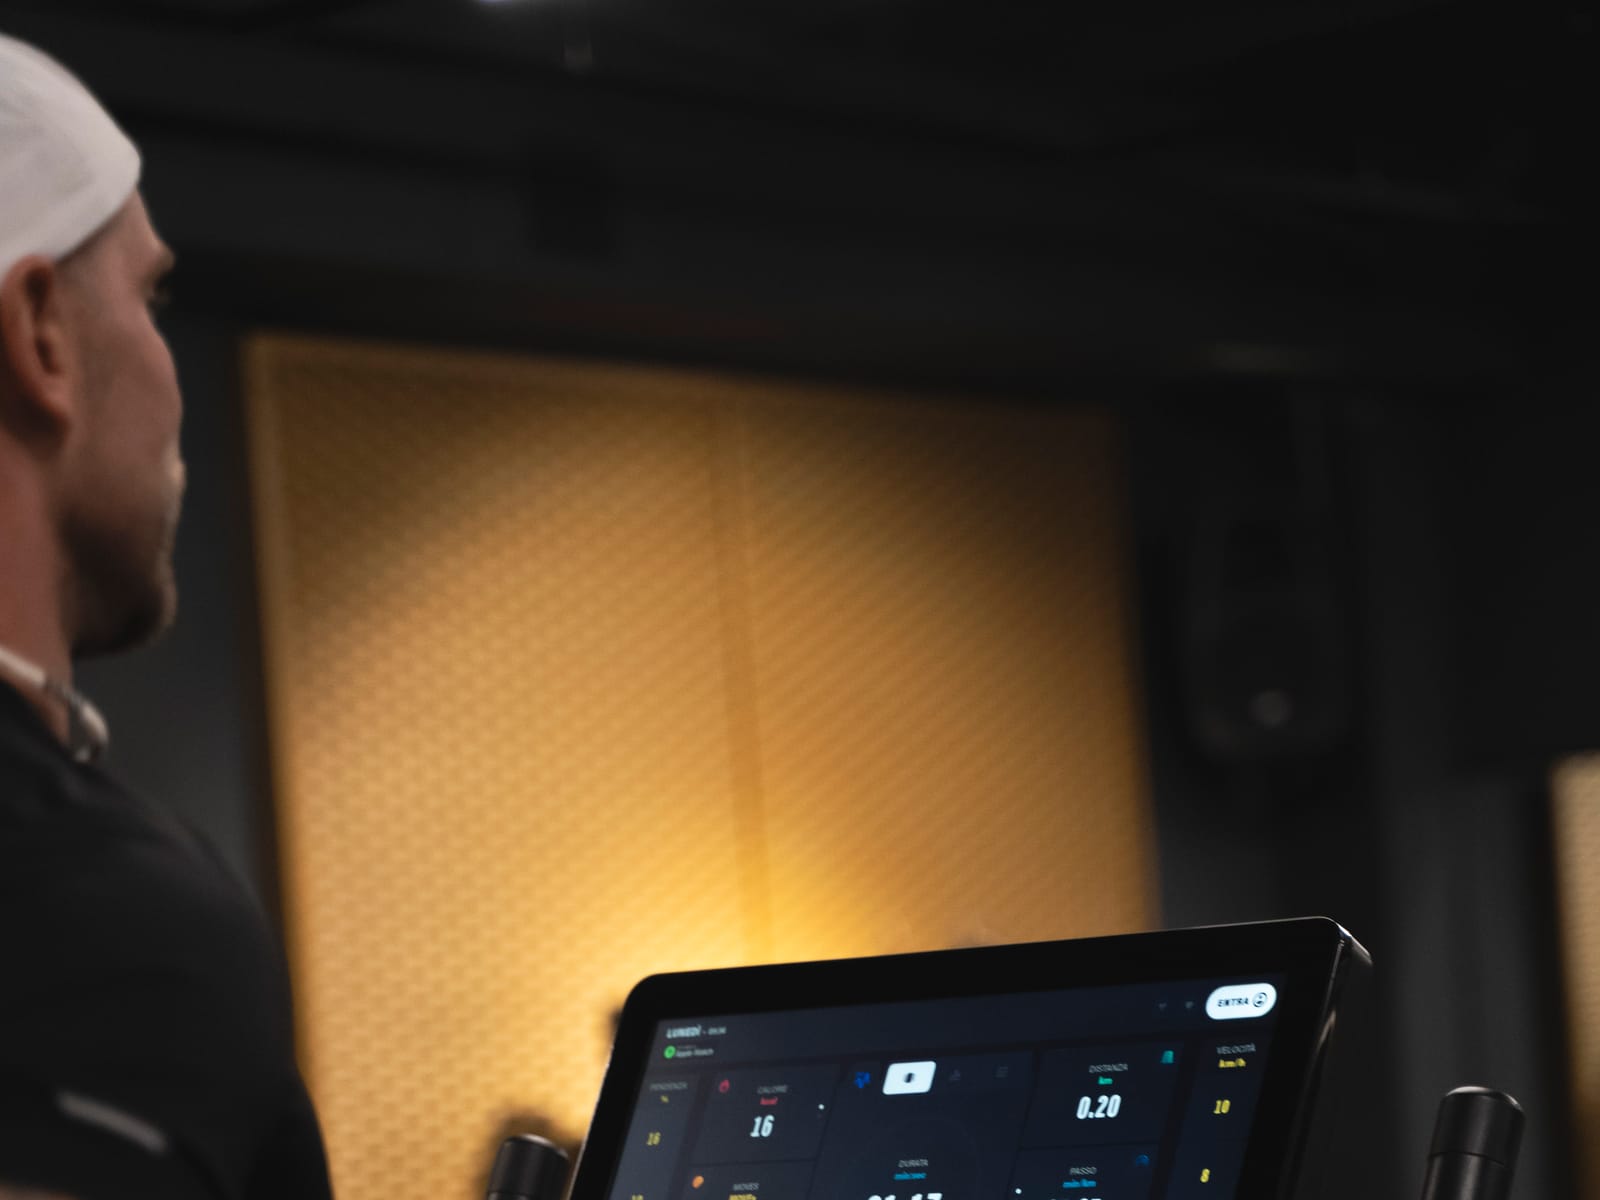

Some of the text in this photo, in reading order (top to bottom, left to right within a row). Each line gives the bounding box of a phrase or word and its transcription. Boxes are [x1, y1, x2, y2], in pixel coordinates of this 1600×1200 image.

[1217, 997, 1249, 1008] ENTRA
[1076, 1094, 1121, 1120] 0.20
[1213, 1099, 1231, 1115] 10
[750, 1115, 775, 1138] 16
[1070, 1166, 1097, 1175] PASSO
[1200, 1168, 1210, 1183] 8
